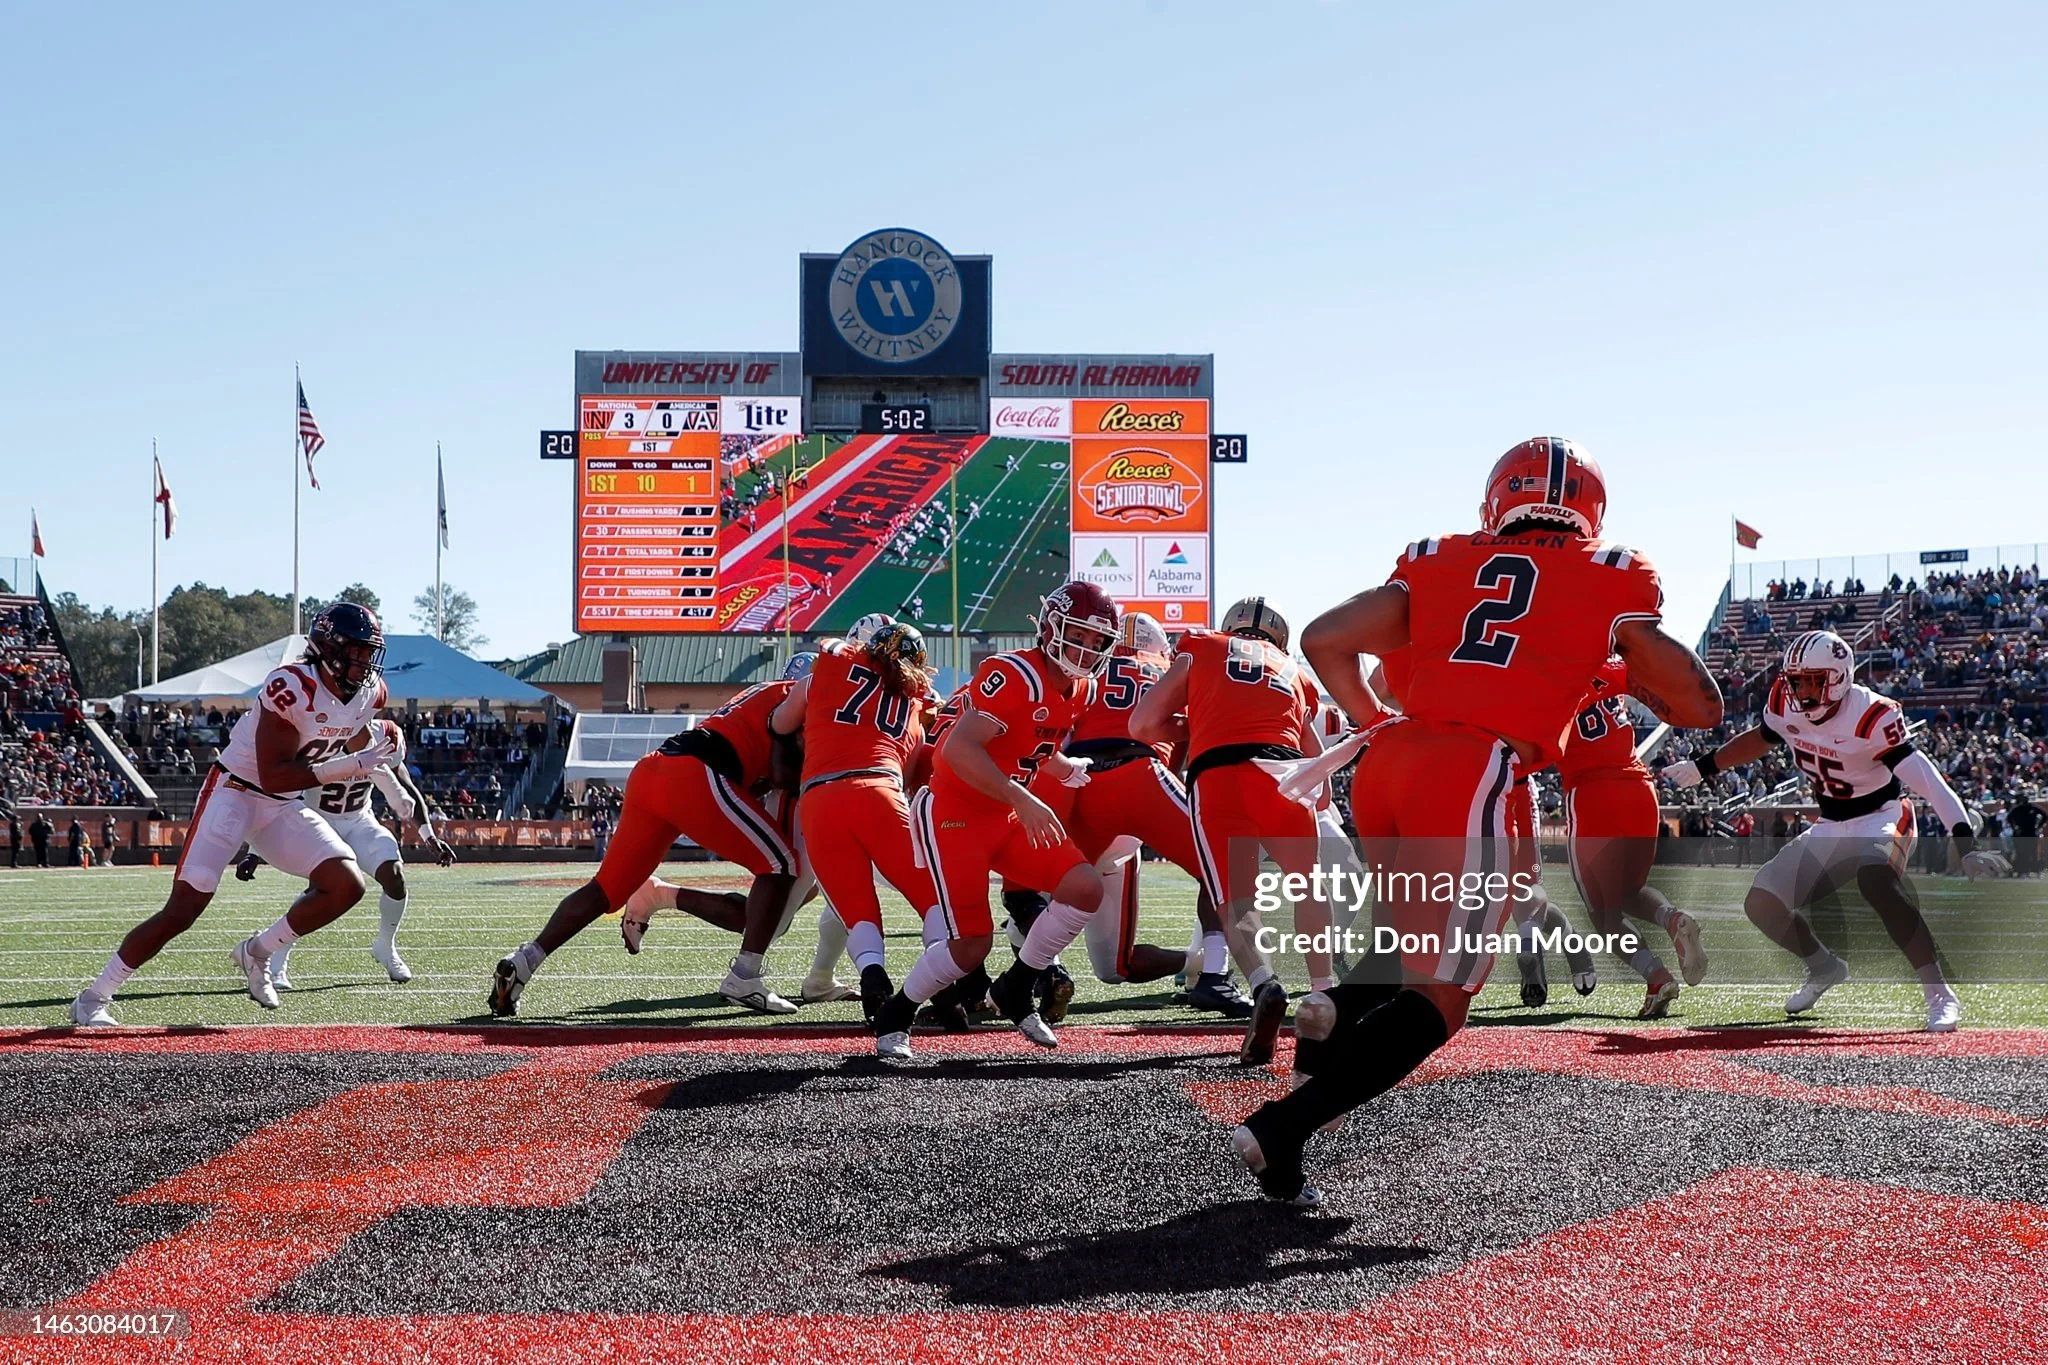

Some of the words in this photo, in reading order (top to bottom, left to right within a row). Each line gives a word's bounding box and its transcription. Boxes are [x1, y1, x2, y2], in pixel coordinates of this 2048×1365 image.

[836, 236, 956, 287] HANCOCK
[838, 307, 953, 358] WHITNEY
[603, 363, 740, 384] UNIVERSITY
[743, 363, 779, 384] OF
[1000, 365, 1077, 386] SOUTH
[1081, 366, 1201, 387] ALABAMA
[624, 413, 634, 428] 3
[662, 413, 672, 428] 0
[745, 404, 788, 431] Lite
[882, 410, 925, 429] 5:02
[1100, 403, 1184, 432] Reese's
[547, 435, 572, 454] 20
[584, 432, 601, 440] POSS
[643, 442, 657, 451] 1ST
[1216, 438, 1241, 458] 20
[1107, 457, 1173, 480] Reese's
[589, 475, 617, 492] 1ST
[637, 475, 656, 492] 10
[687, 475, 696, 492] 1
[1553, 488, 1558, 497] 2
[1097, 484, 1146, 514] SENIOR
[1149, 484, 1185, 511] BOWL
[695, 507, 702, 515] 0
[692, 527, 704, 535] 44
[692, 547, 704, 556] 44
[599, 568, 606, 576] 4
[695, 568, 702, 576] 2
[1077, 572, 1133, 583] REGIONS
[1149, 569, 1202, 581] Alabama
[599, 588, 606, 596] 0
[695, 588, 702, 596] 0
[1157, 582, 1194, 594] Power
[687, 608, 707, 616] 4:17
[1449, 553, 1540, 669] 2
[979, 670, 1006, 698] 9
[266, 677, 298, 713] 92
[834, 664, 912, 741] 70
[1793, 746, 1854, 800] 55
[320, 782, 375, 815] 22
